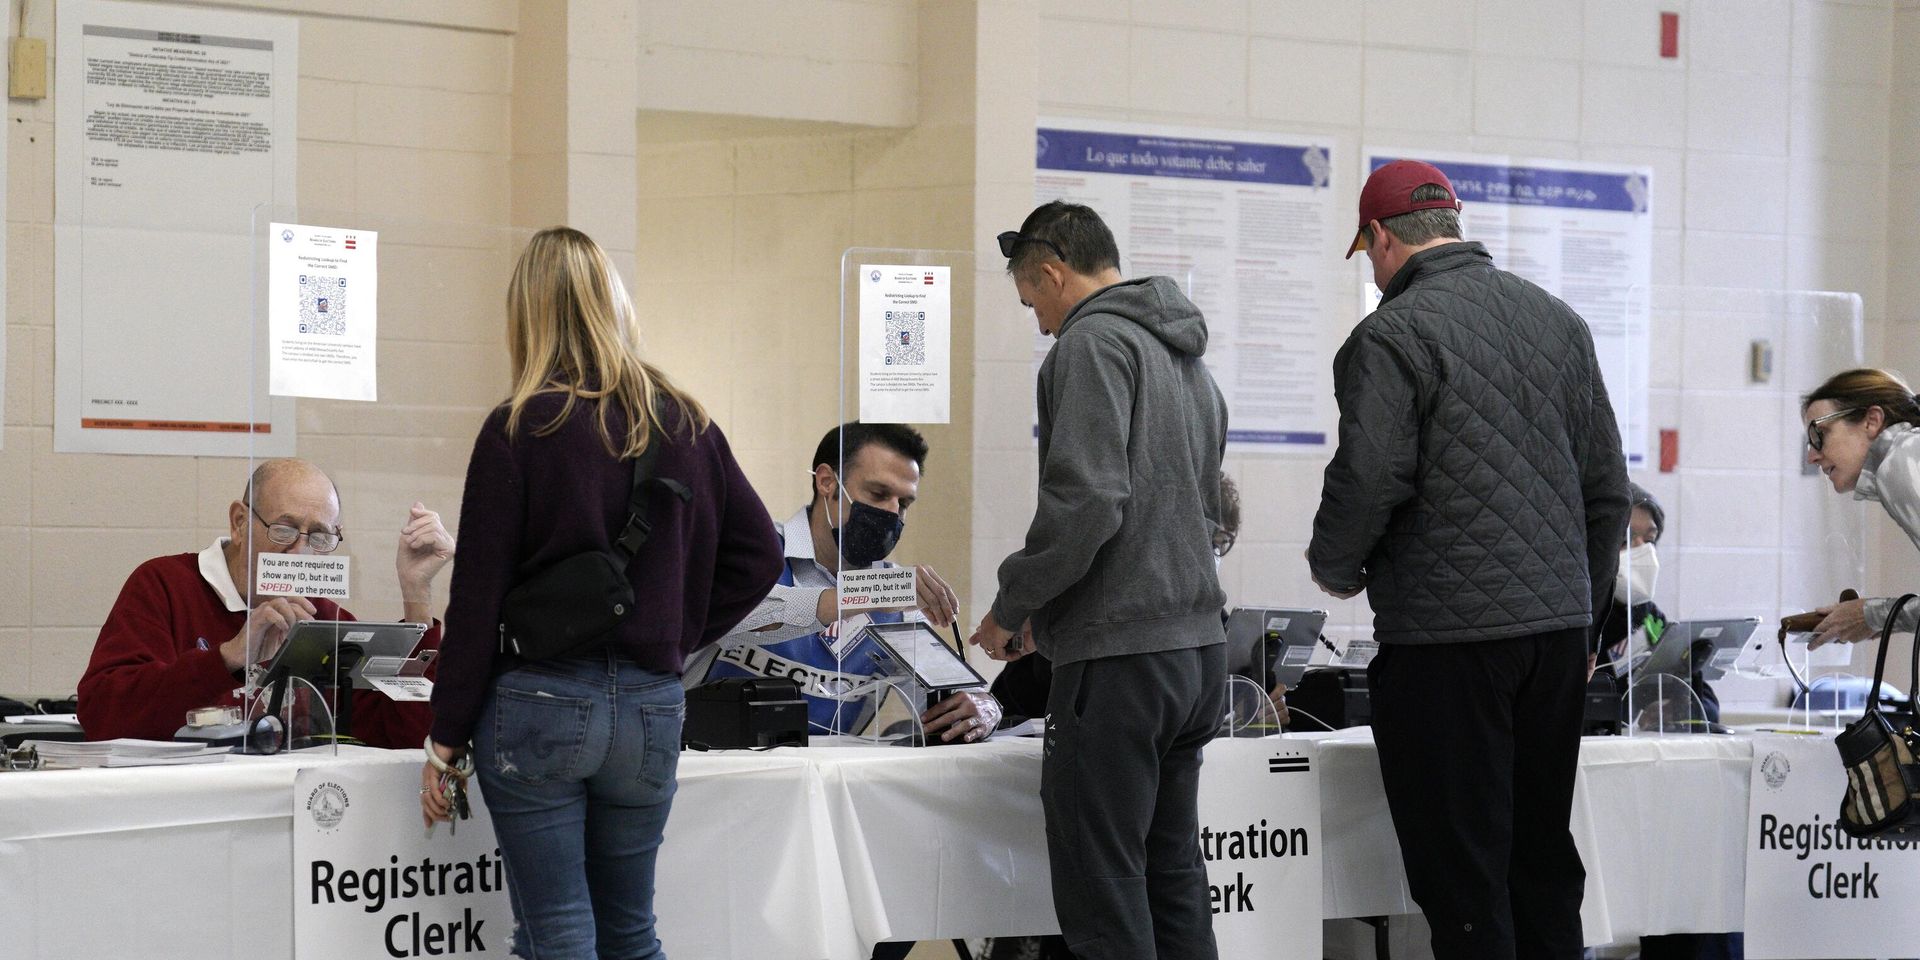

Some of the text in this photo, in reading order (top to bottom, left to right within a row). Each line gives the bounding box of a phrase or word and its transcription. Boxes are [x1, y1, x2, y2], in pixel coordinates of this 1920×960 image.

[1086, 146, 1266, 173] Lo que todo votante debe saber
[263, 558, 276, 566] You
[879, 571, 904, 580] required
[259, 583, 292, 592] SPEED
[283, 573, 296, 582] any
[298, 573, 307, 581] ID,
[841, 596, 869, 605] SPEED
[1200, 819, 1308, 861] tration
[311, 848, 502, 914] Registrati
[1209, 872, 1254, 914] erk
[1808, 862, 1879, 898] Clerk
[385, 908, 486, 958] Clerk
